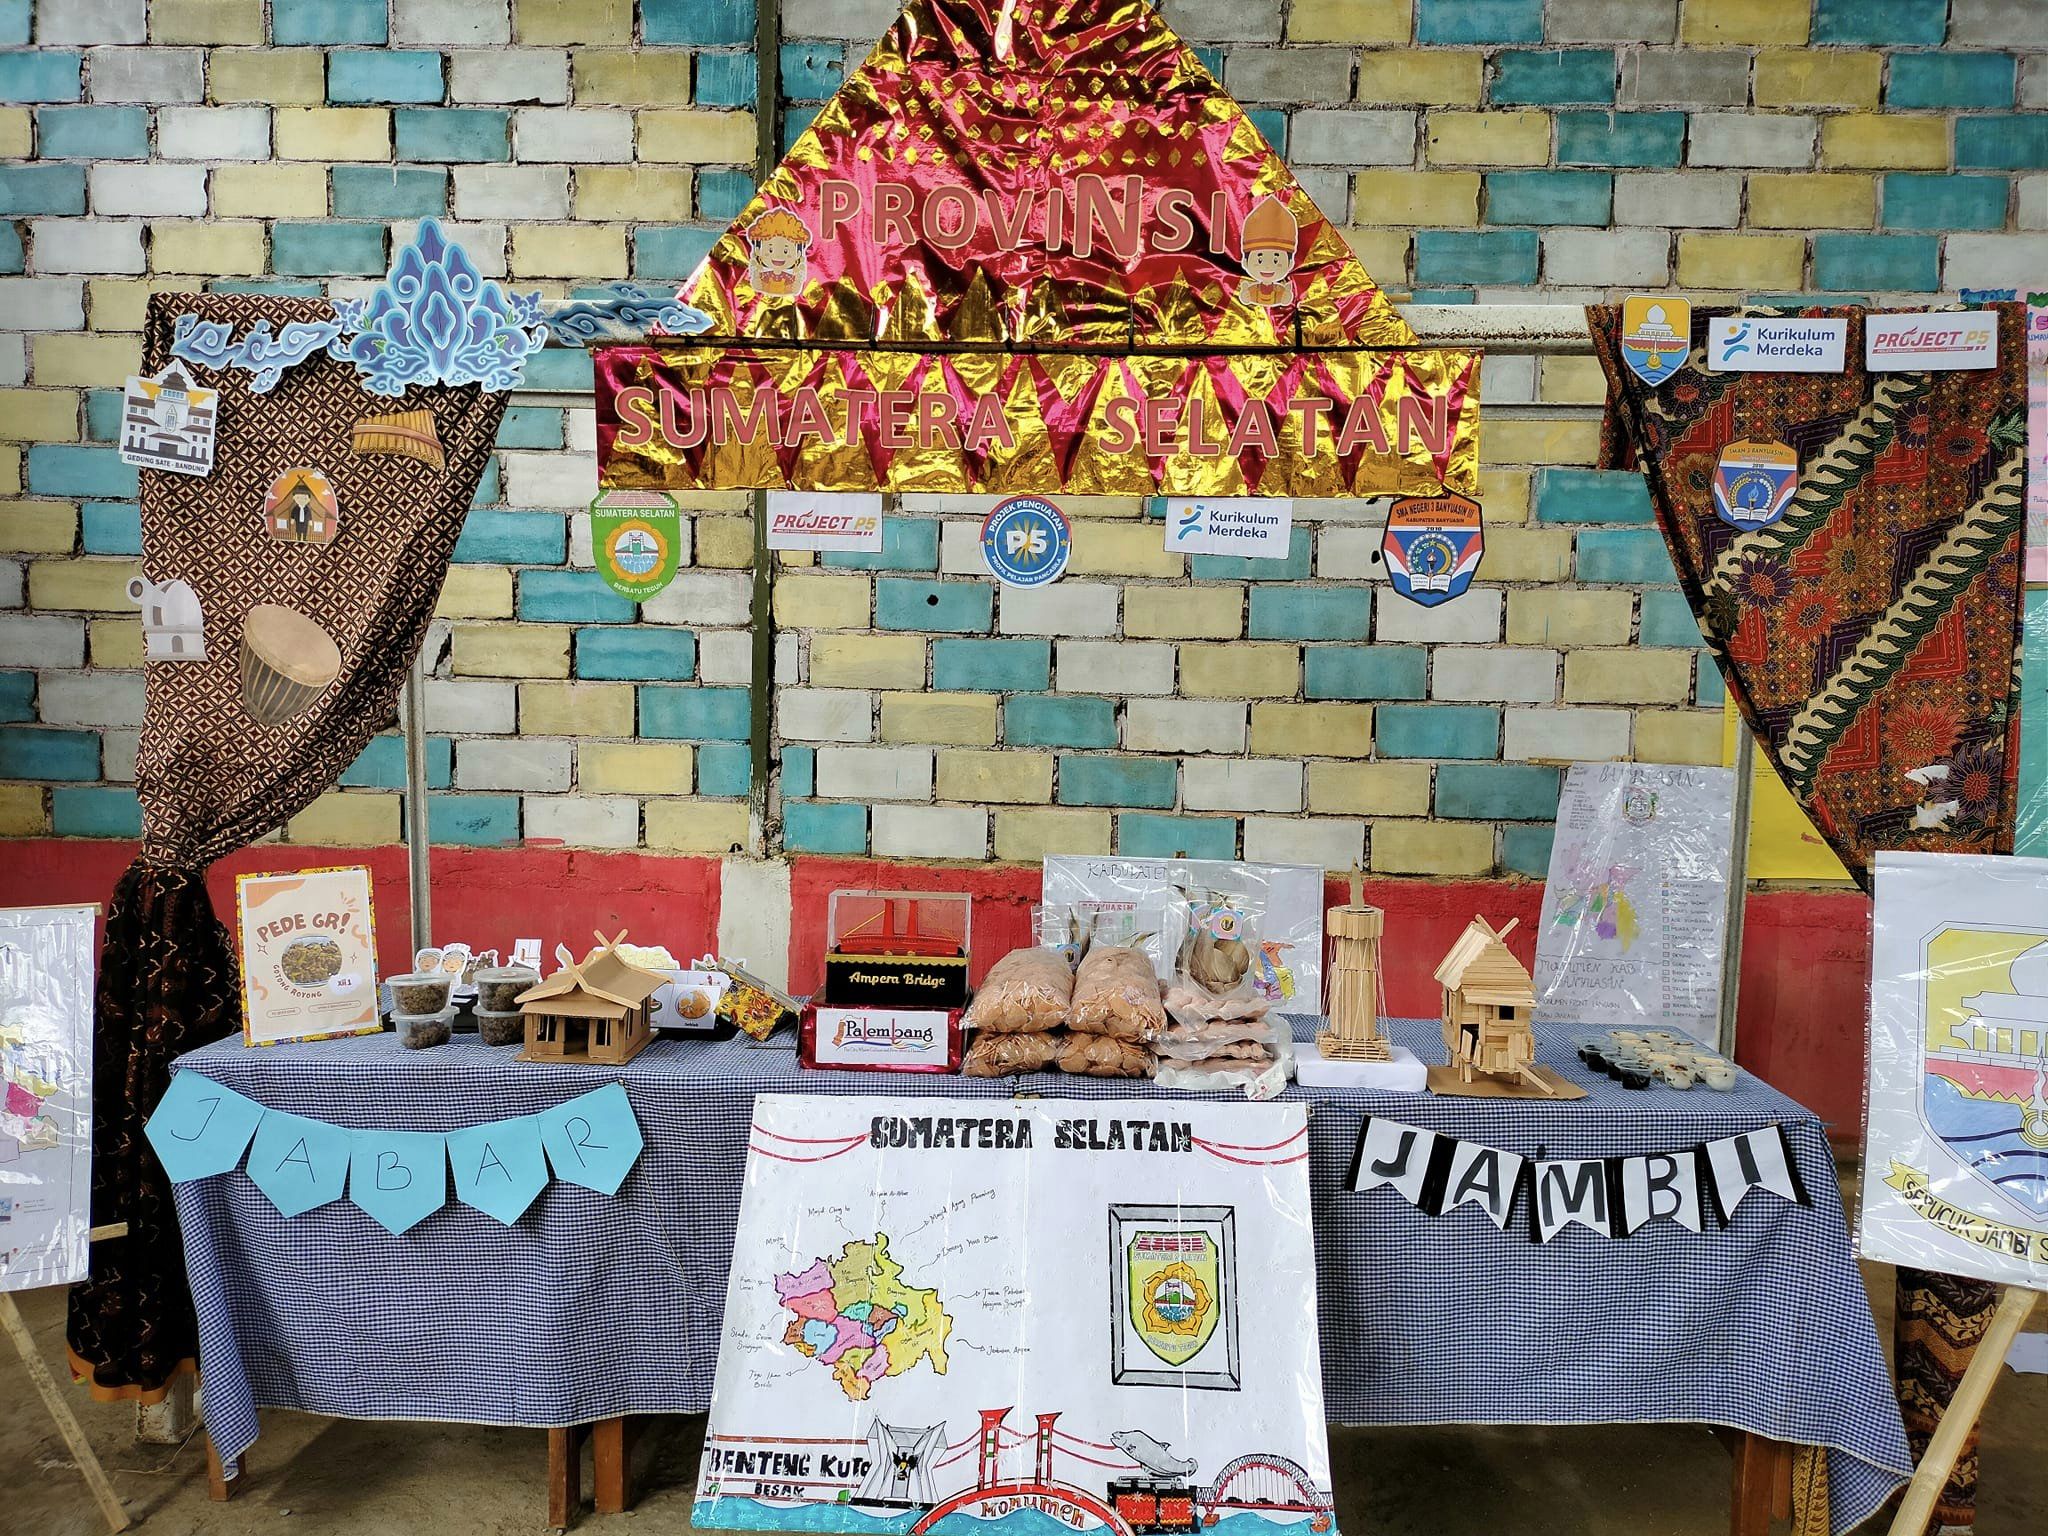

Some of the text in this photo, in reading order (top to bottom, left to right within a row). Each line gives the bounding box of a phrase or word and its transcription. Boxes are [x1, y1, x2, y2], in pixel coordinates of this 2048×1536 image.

[819, 173, 1227, 258] PROVINSI
[1757, 328, 1835, 341] Kurikulum
[1874, 327, 1991, 348] PROJECT P5
[1757, 343, 1823, 356] Merdeka
[616, 387, 1450, 459] SUMATERA SELATAN
[127, 454, 155, 464] GEDUNG
[175, 463, 205, 473] BANDUNG
[595, 509, 675, 518] SUMATERA SELATAN
[773, 511, 877, 530] PROJECT P5
[988, 500, 1065, 533] PROJEK PENGUATAN
[1209, 510, 1279, 525] Kurikulum
[1396, 507, 1408, 519] SMA
[1409, 502, 1430, 514] NEGERI
[1430, 501, 1435, 512] 3
[1436, 501, 1467, 516] BANYUASIN
[1006, 529, 1047, 555] P5
[1208, 524, 1268, 539] Merdeka
[1006, 572, 1034, 582] PELAJAR
[1034, 558, 1062, 582] PANCASILA
[613, 582, 642, 594] BERSATU
[256, 912, 352, 943] PEDE GR!
[273, 964, 322, 999] GOTONG ROYONG
[848, 971, 946, 989] Ampera Bridge
[845, 1017, 935, 1044] Palembang
[170, 1096, 608, 1190] JABAR
[870, 1115, 1193, 1153] SUMATERA SELATAN
[1370, 1130, 1762, 1228] JAMBI
[1904, 1180, 1976, 1238] SEPUCUK
[1975, 1223, 2033, 1256] JAMBI
[709, 1449, 811, 1478] BENTENG
[753, 1482, 806, 1498] BESAK
